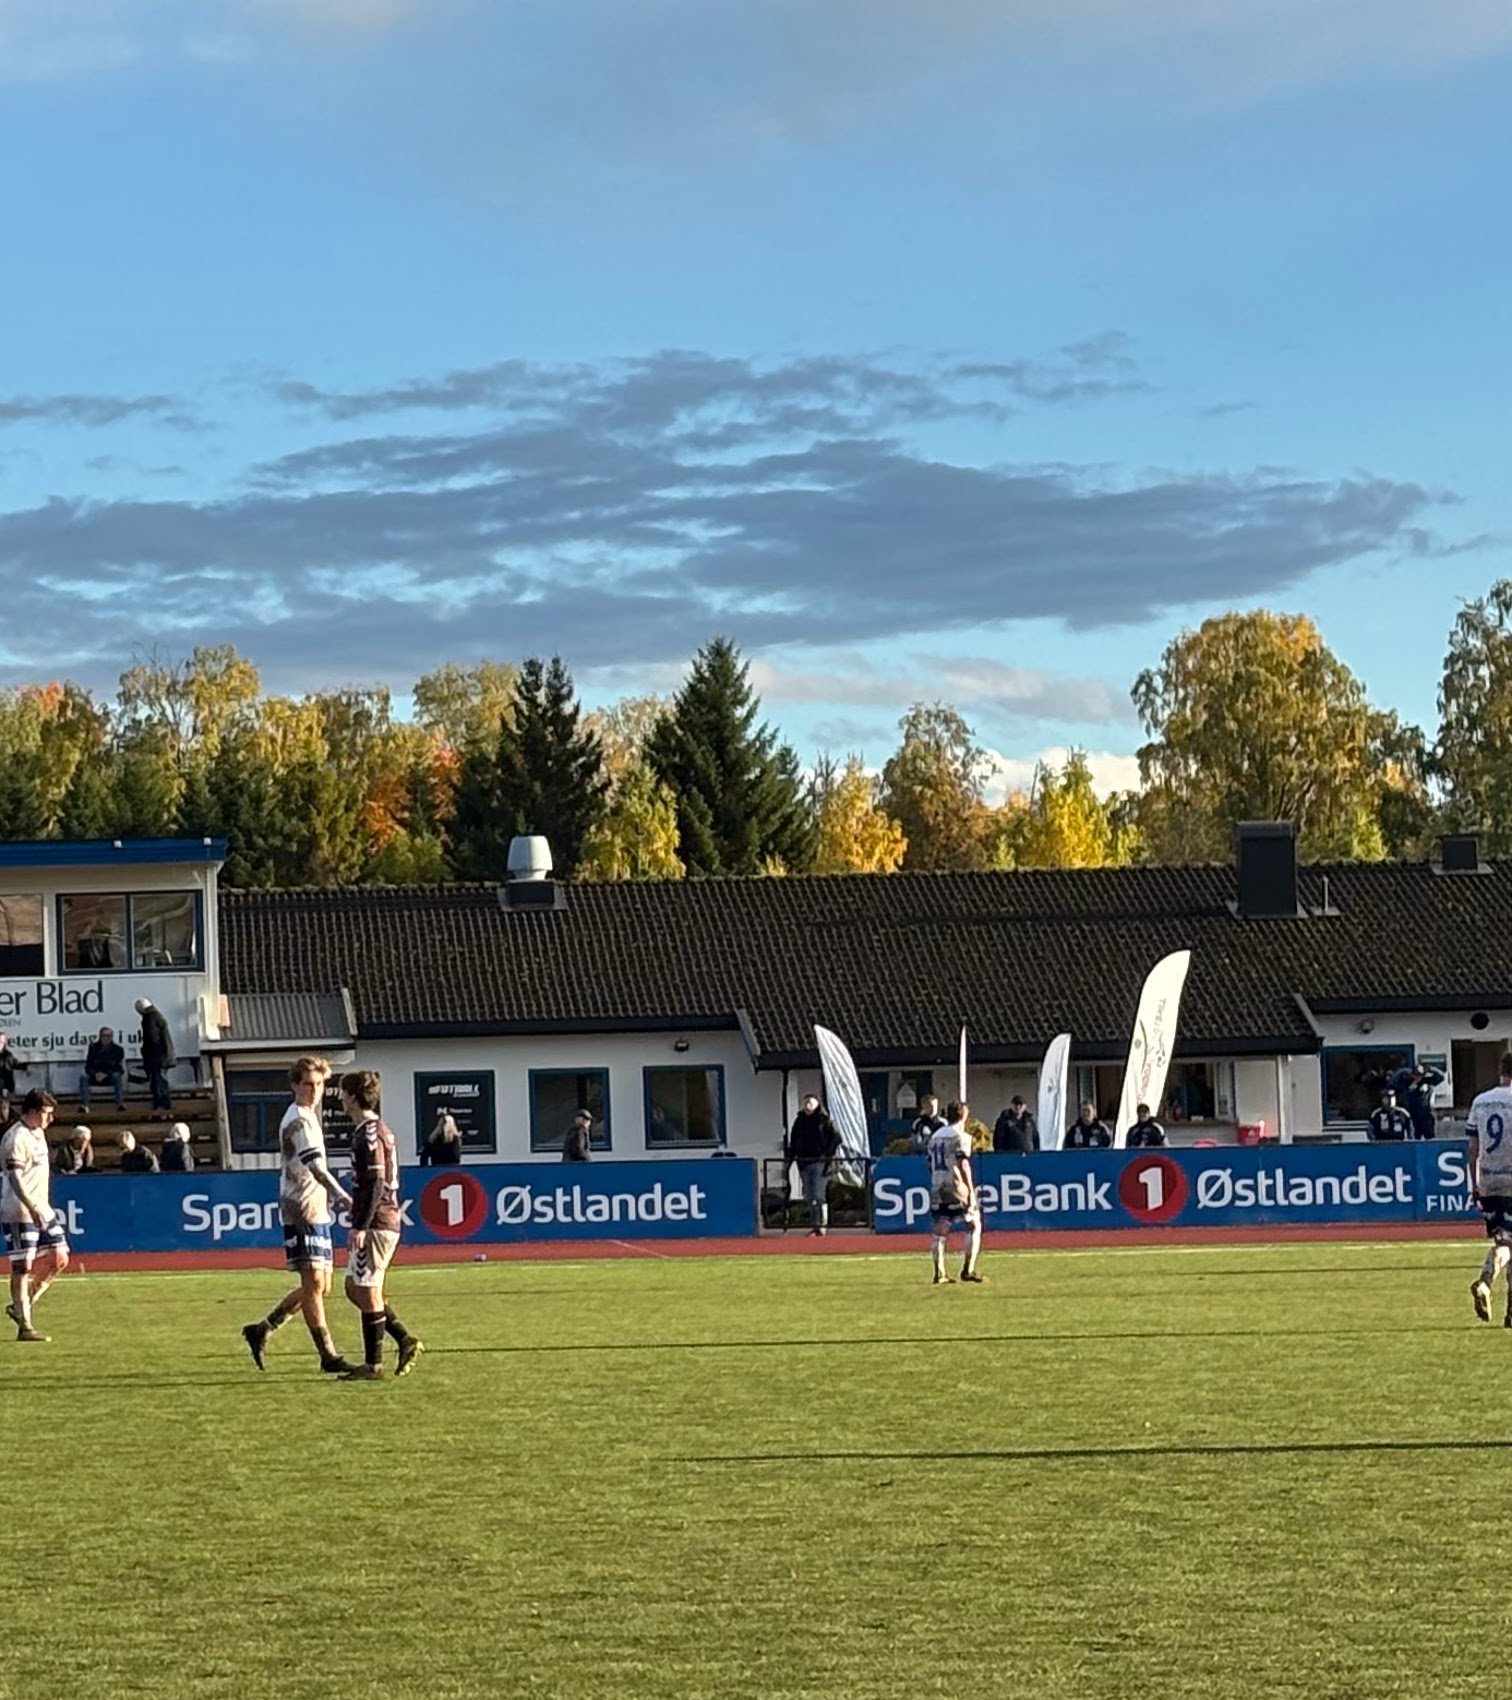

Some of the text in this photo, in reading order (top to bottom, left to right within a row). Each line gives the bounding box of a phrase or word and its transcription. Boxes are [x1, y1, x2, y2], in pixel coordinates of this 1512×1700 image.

[36, 980, 103, 1015] Blad
[41, 1031, 65, 1051] sju
[1485, 1113, 1504, 1154] 9
[439, 1183, 465, 1226] 1
[496, 1182, 707, 1225] Østlandet
[873, 1172, 1112, 1225] SpeBank
[1138, 1166, 1163, 1211] 1
[1196, 1164, 1413, 1210] Østlandet
